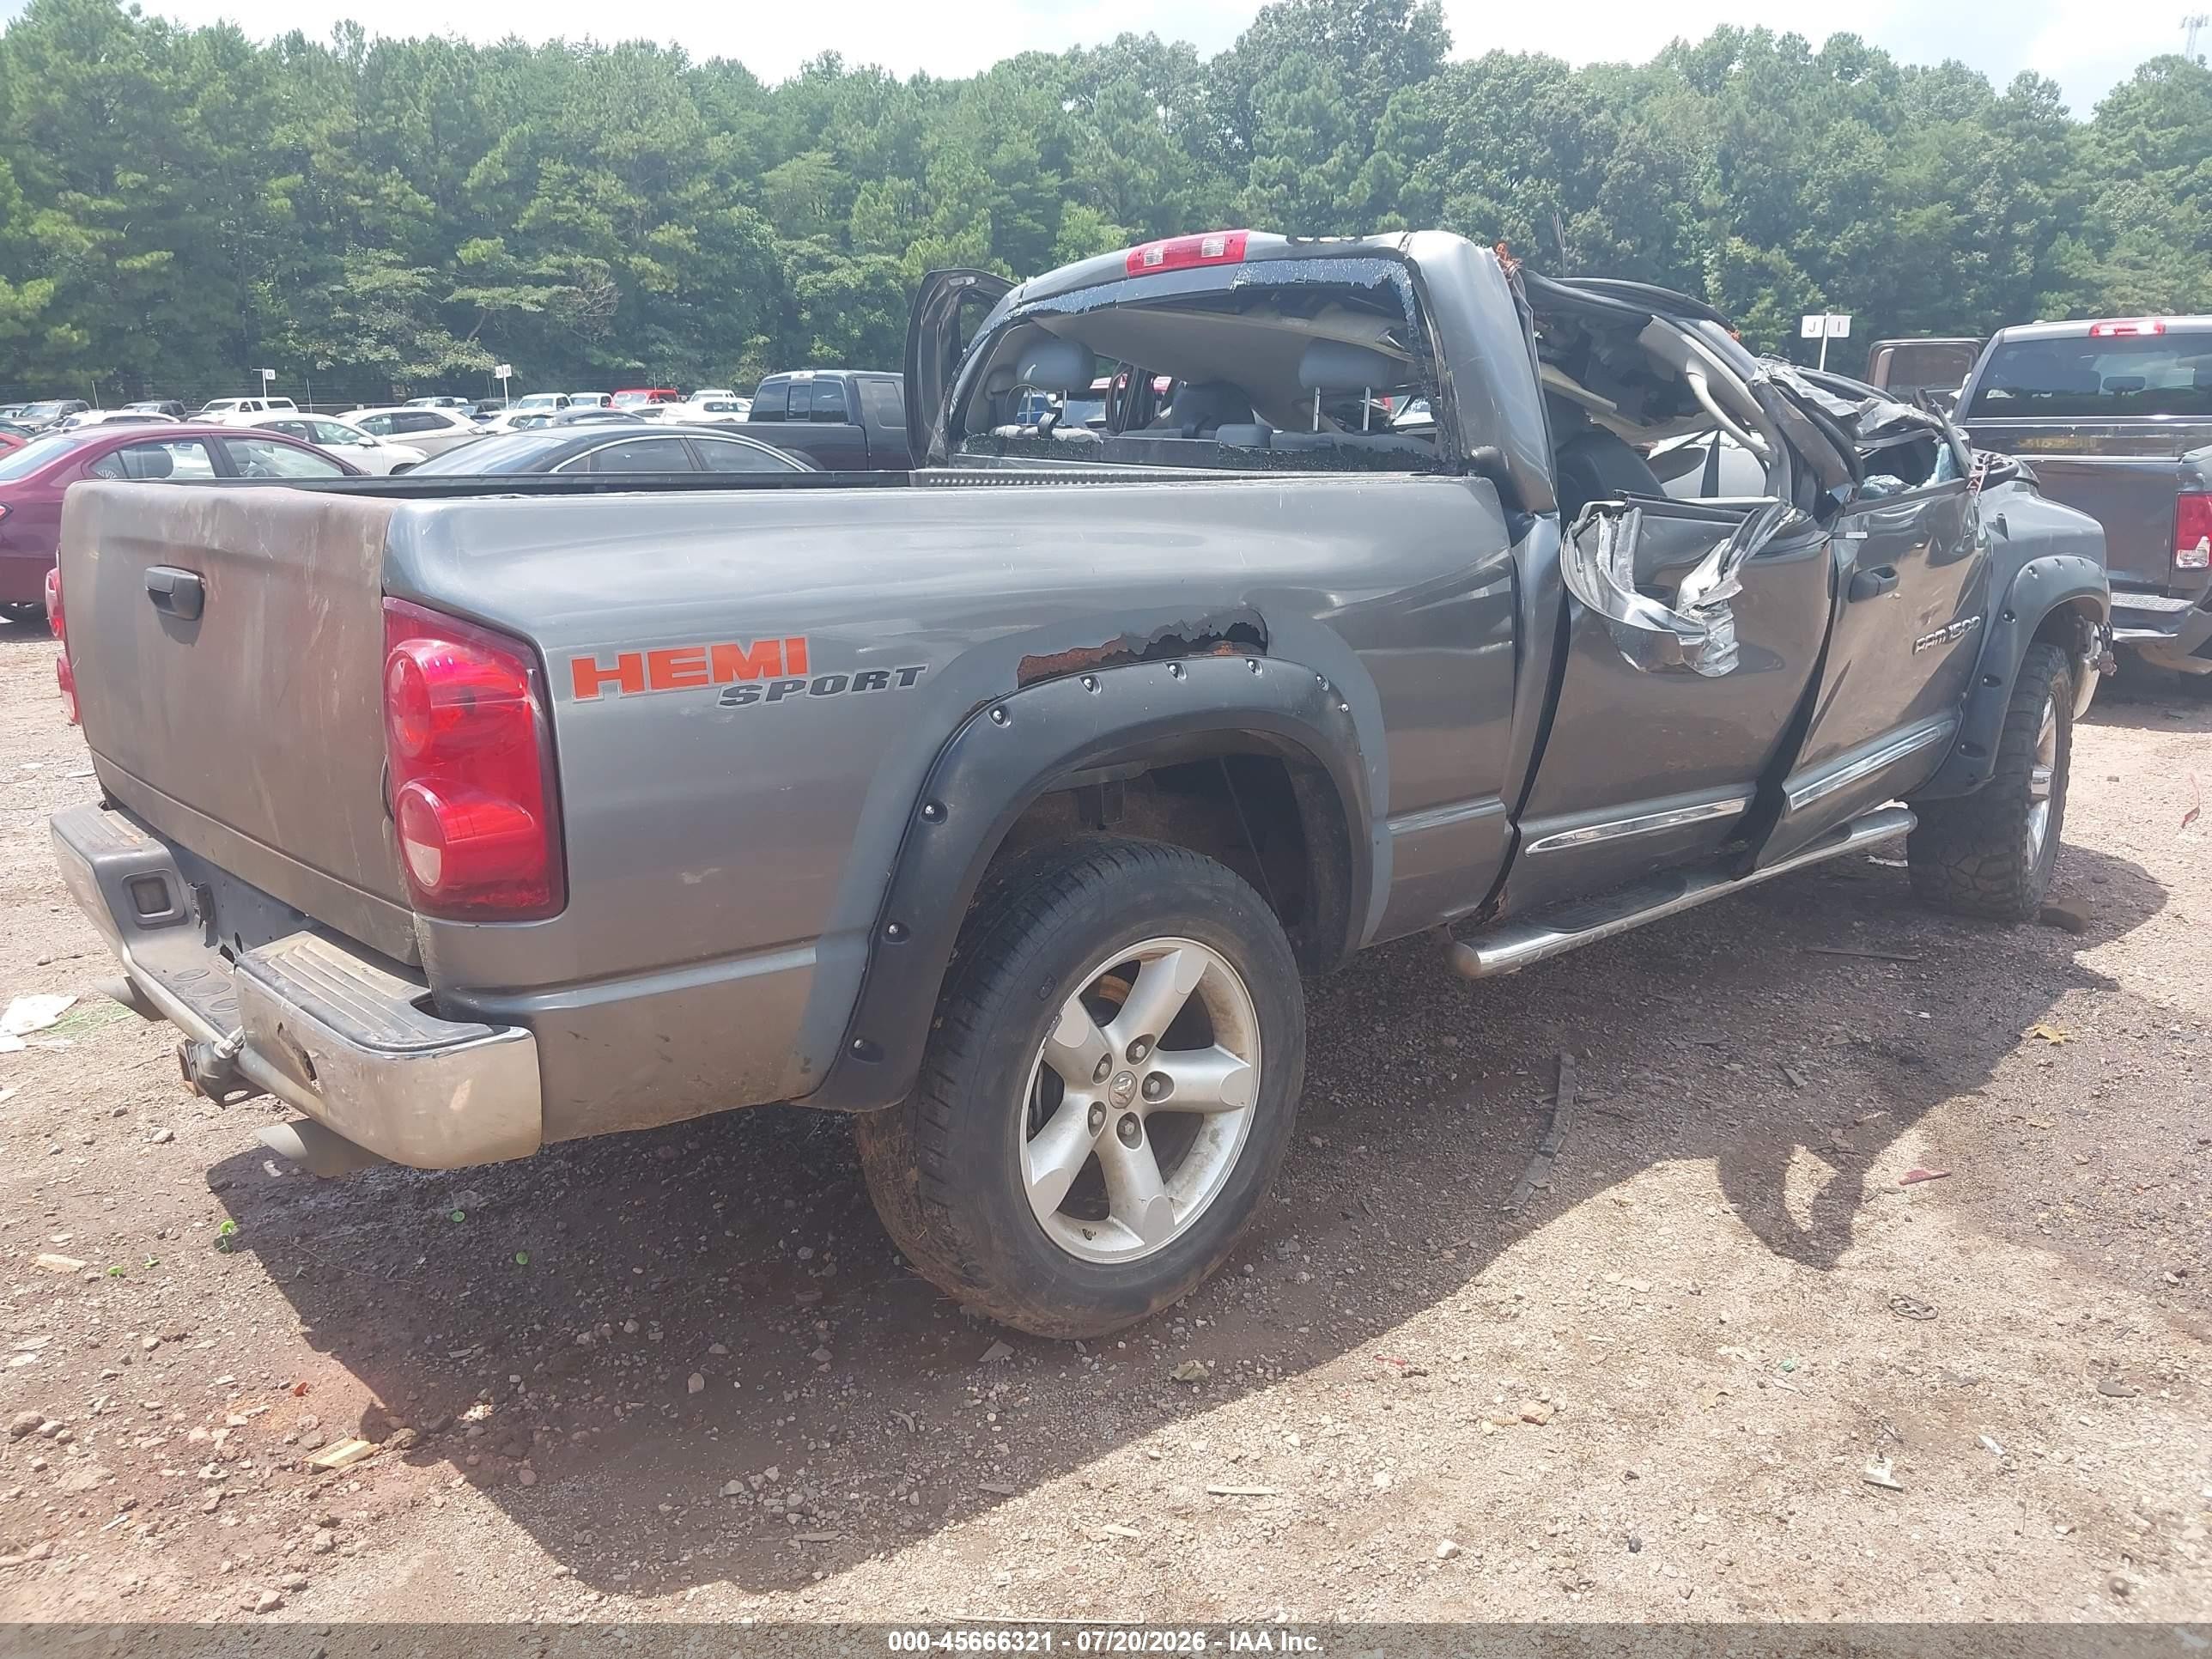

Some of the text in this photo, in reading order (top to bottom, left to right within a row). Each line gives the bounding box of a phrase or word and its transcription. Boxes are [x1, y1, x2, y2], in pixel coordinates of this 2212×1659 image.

[1808, 321, 1817, 333] J
[1948, 615, 1981, 641] 1500
[570, 635, 810, 701] HEMI
[718, 665, 927, 707] SPORT
